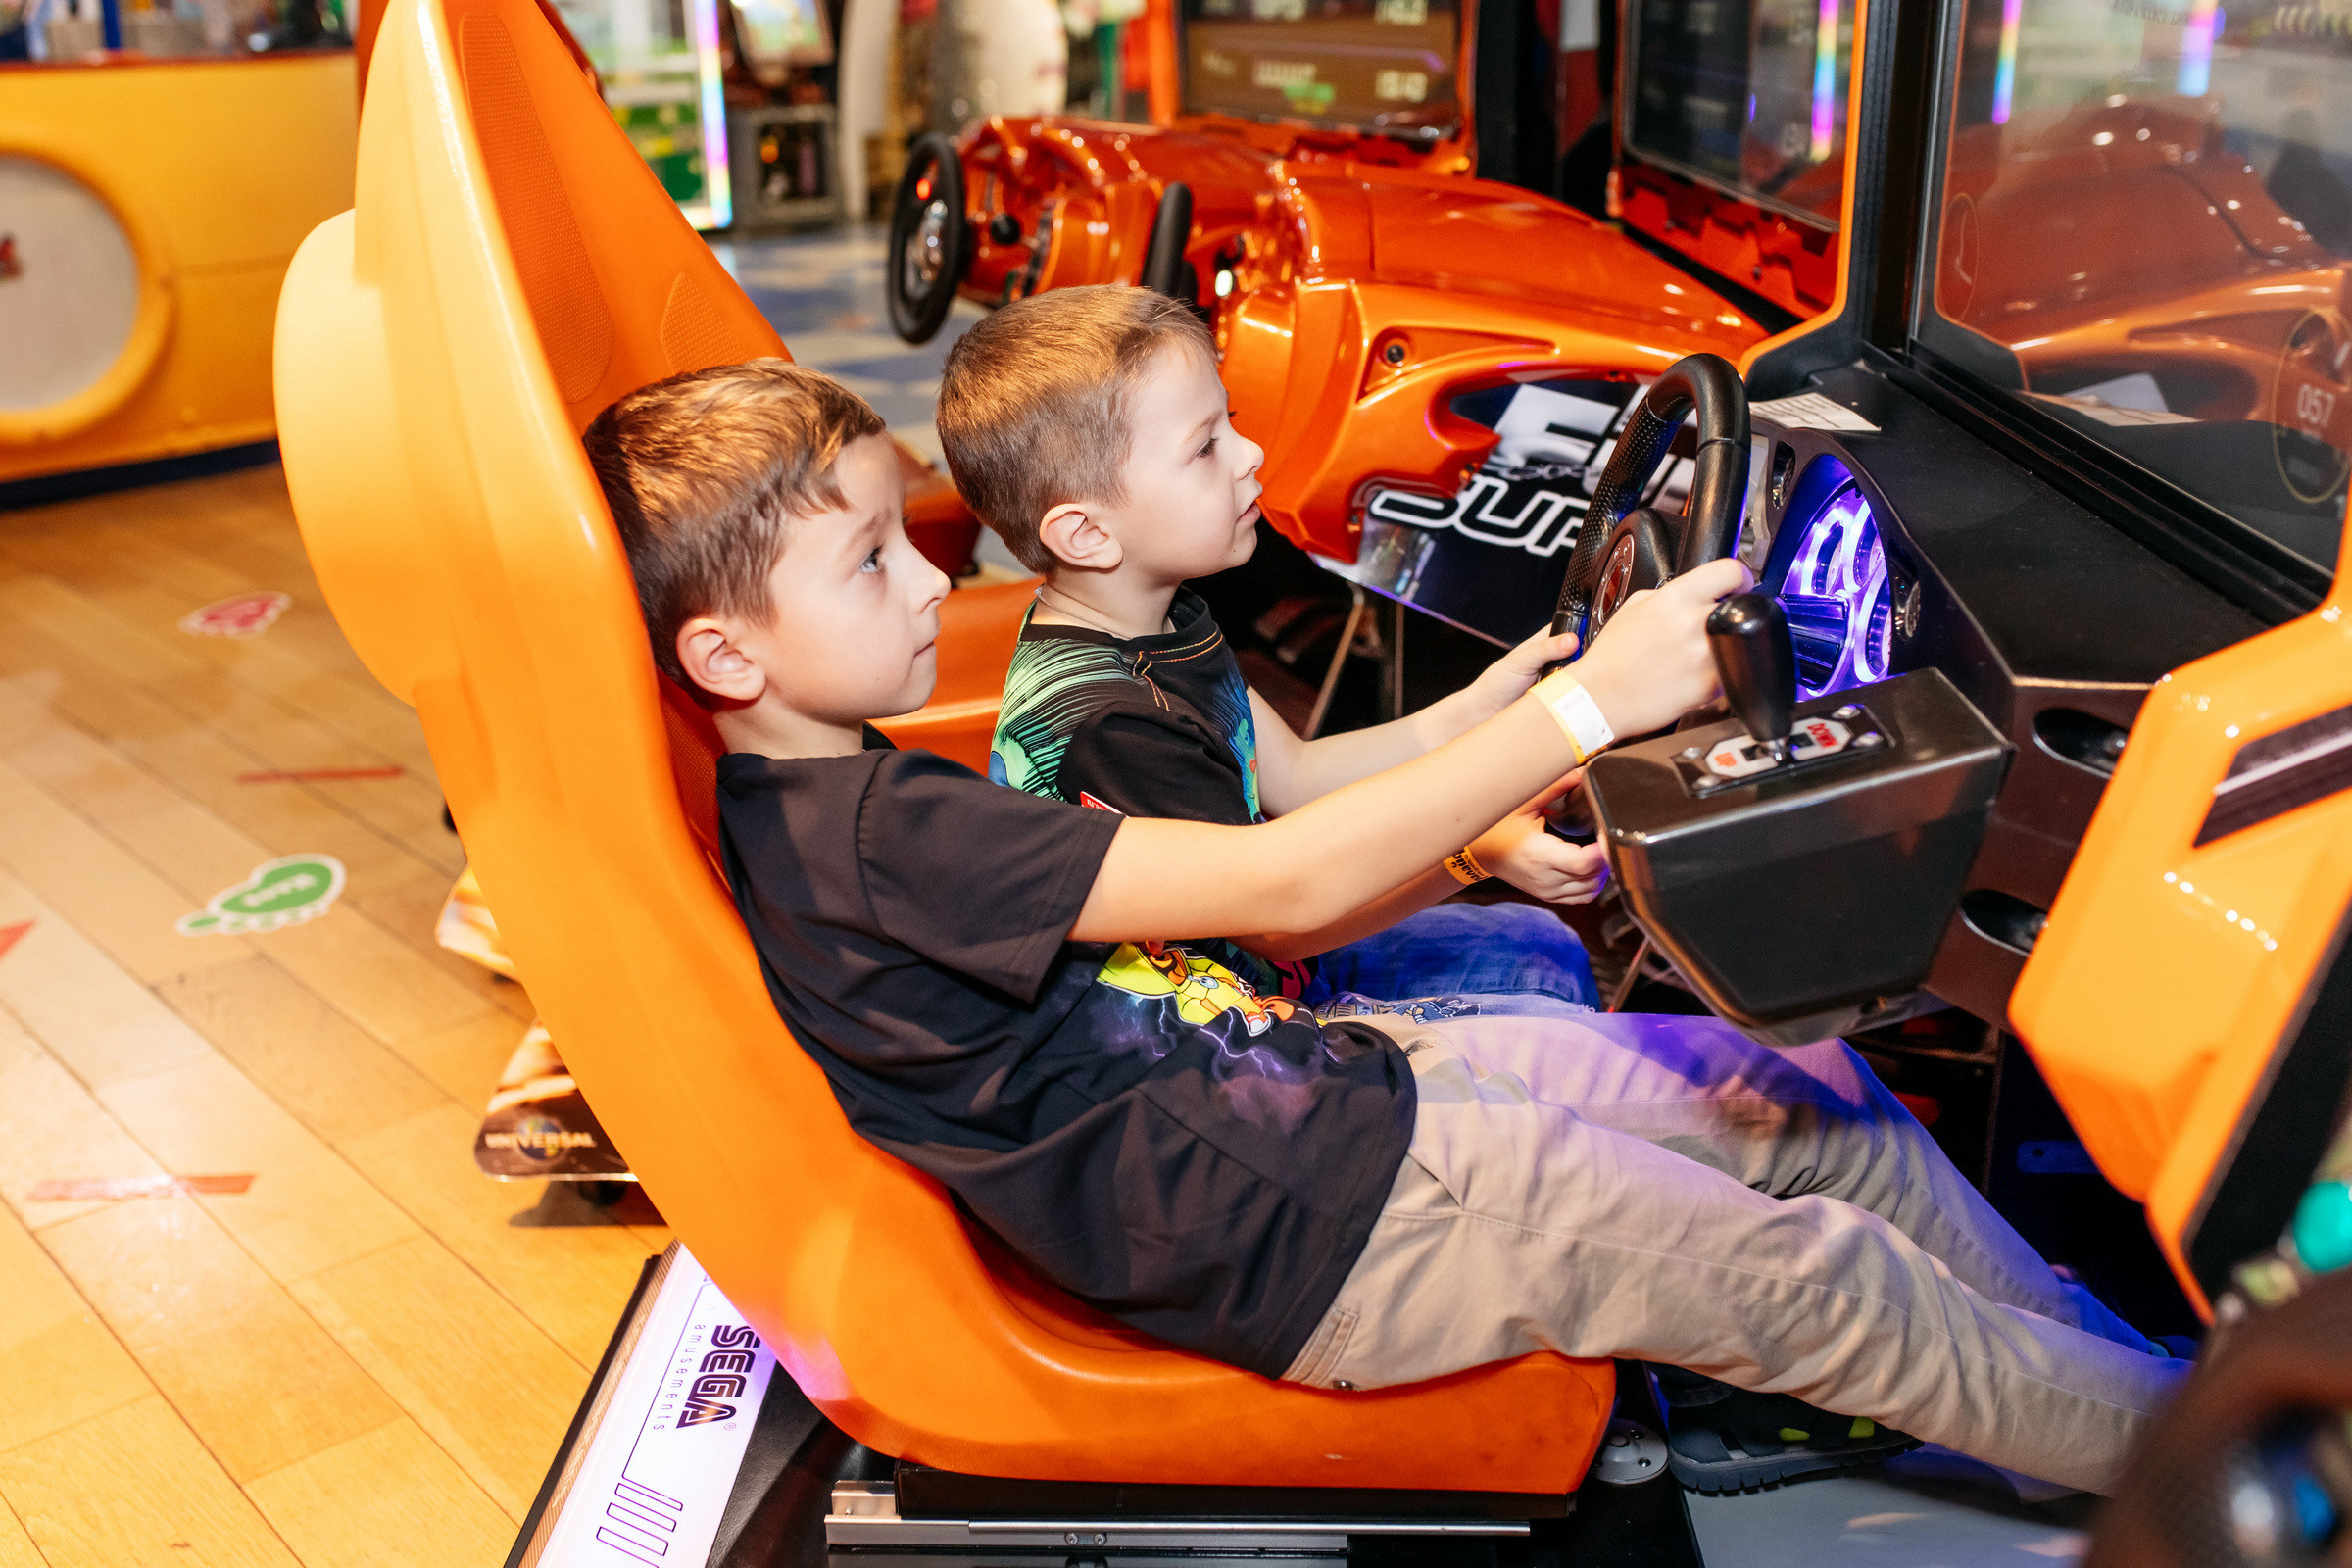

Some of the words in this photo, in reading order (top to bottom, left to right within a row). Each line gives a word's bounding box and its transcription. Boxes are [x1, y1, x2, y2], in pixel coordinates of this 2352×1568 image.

[1807, 722, 1839, 749] DOWN
[484, 1131, 598, 1149] UNIVERSAL
[653, 1324, 706, 1430] amusements
[675, 1325, 761, 1429] SEGA
